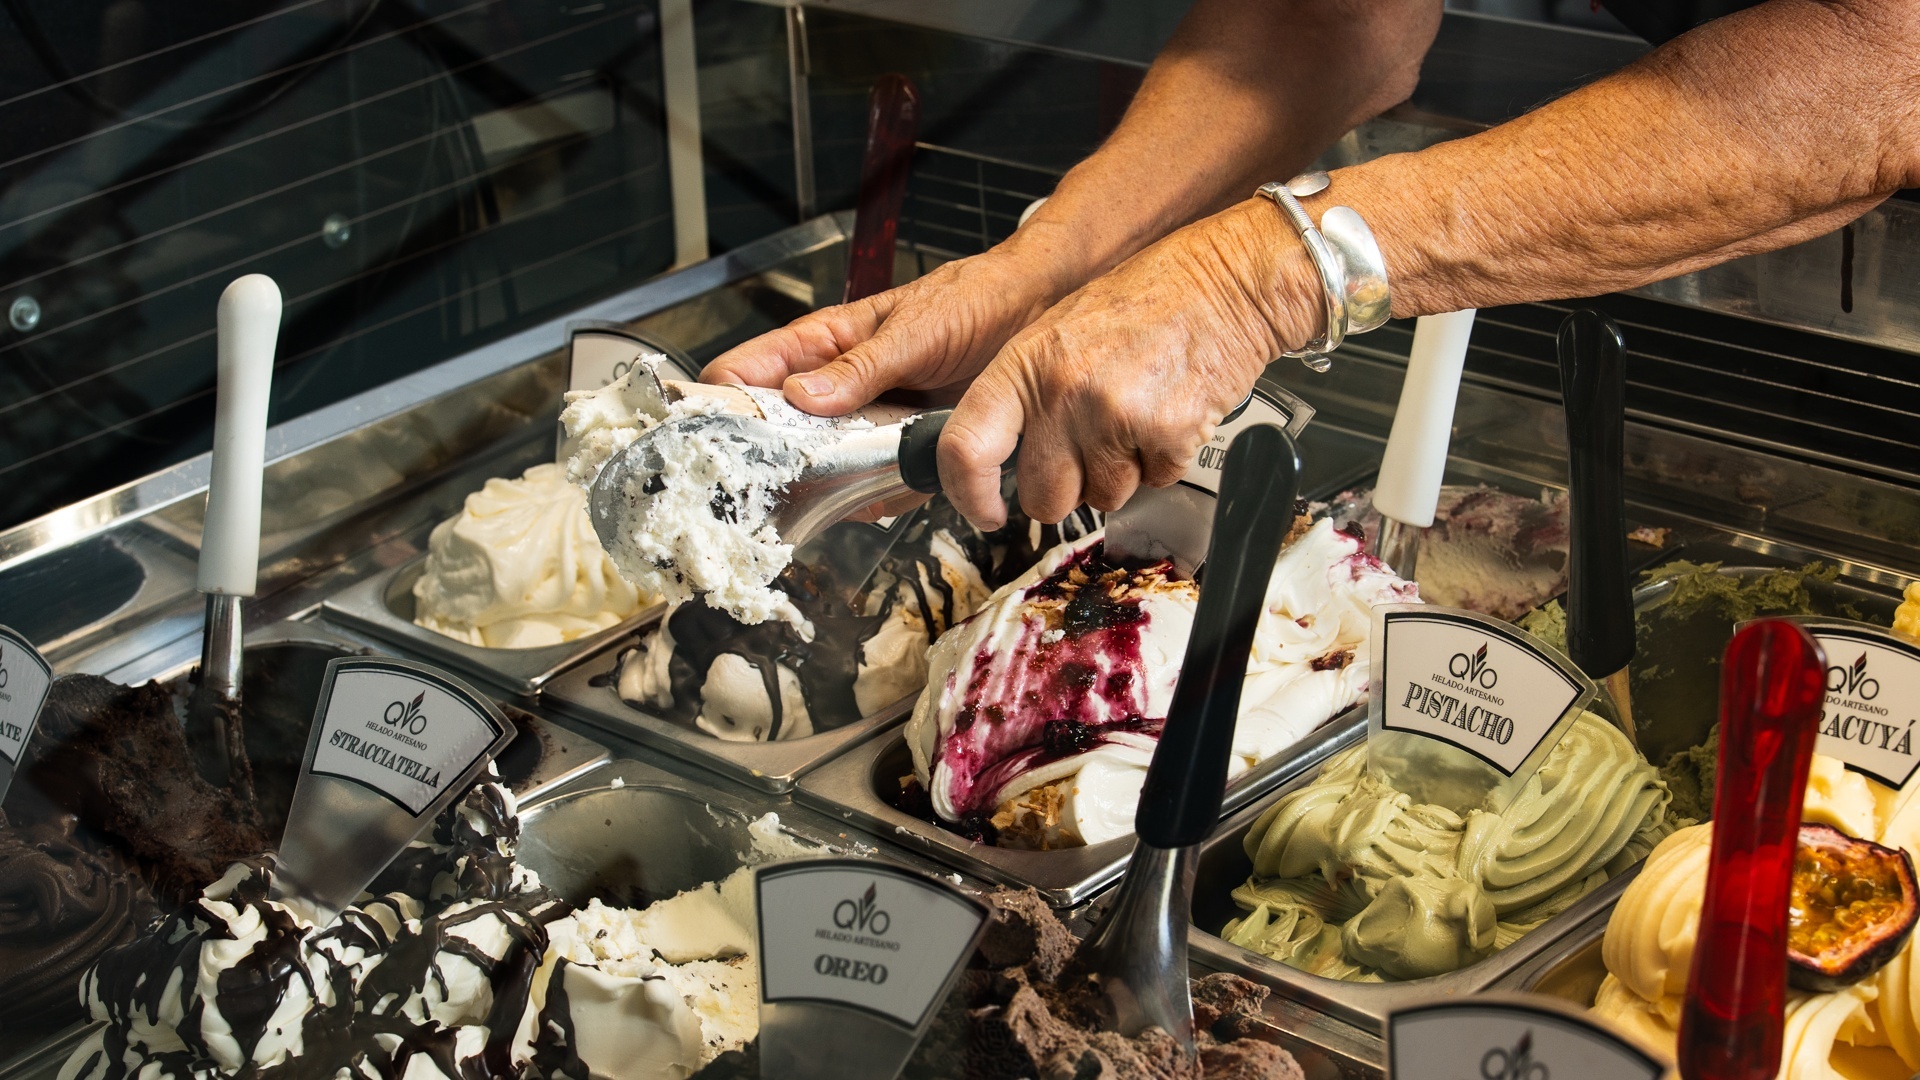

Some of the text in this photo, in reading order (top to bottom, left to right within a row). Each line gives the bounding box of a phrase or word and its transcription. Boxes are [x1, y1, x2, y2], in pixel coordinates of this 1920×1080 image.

[1198, 445, 1227, 470] QUE
[1448, 652, 1498, 690] QVO
[1826, 665, 1880, 701] QVO
[1431, 673, 1505, 707] HELADO ARTESANO
[383, 700, 428, 736] QVO
[1402, 682, 1514, 745] PISTACHO
[1842, 700, 1889, 717] ARTESANO
[365, 720, 428, 751] HELADO ARTESANO
[329, 729, 441, 788] STRACCIATELLA
[833, 898, 891, 936] QVO
[815, 928, 901, 952] HELADO ARTESANO
[814, 953, 889, 986] OREO
